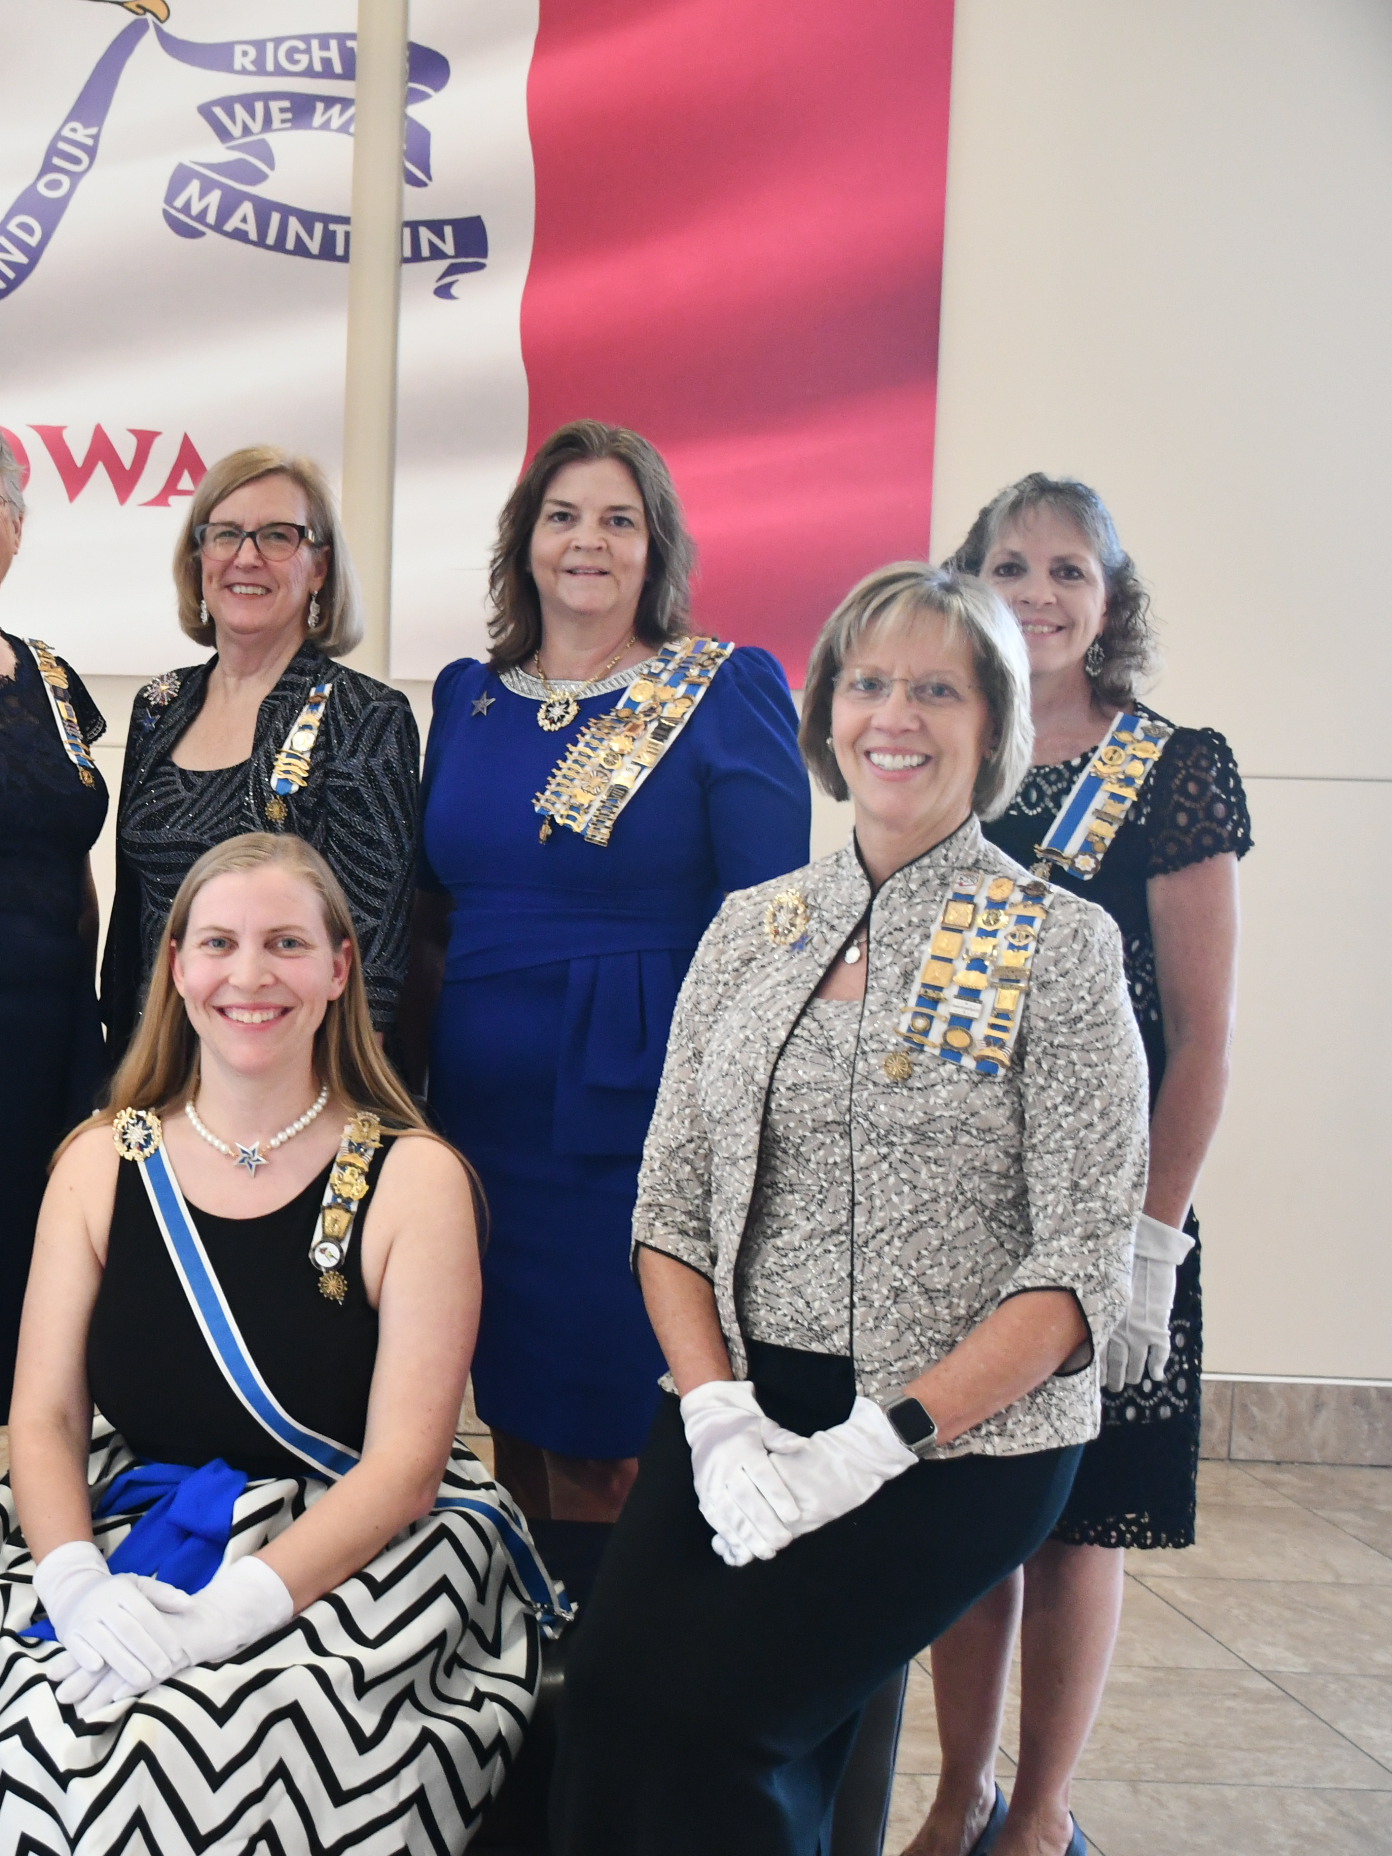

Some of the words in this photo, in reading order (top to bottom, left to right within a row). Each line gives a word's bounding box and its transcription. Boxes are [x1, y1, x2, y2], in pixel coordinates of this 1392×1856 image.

[211, 99, 292, 138] WE
[36, 120, 99, 198] OUR
[172, 177, 456, 258] MAINTIN
